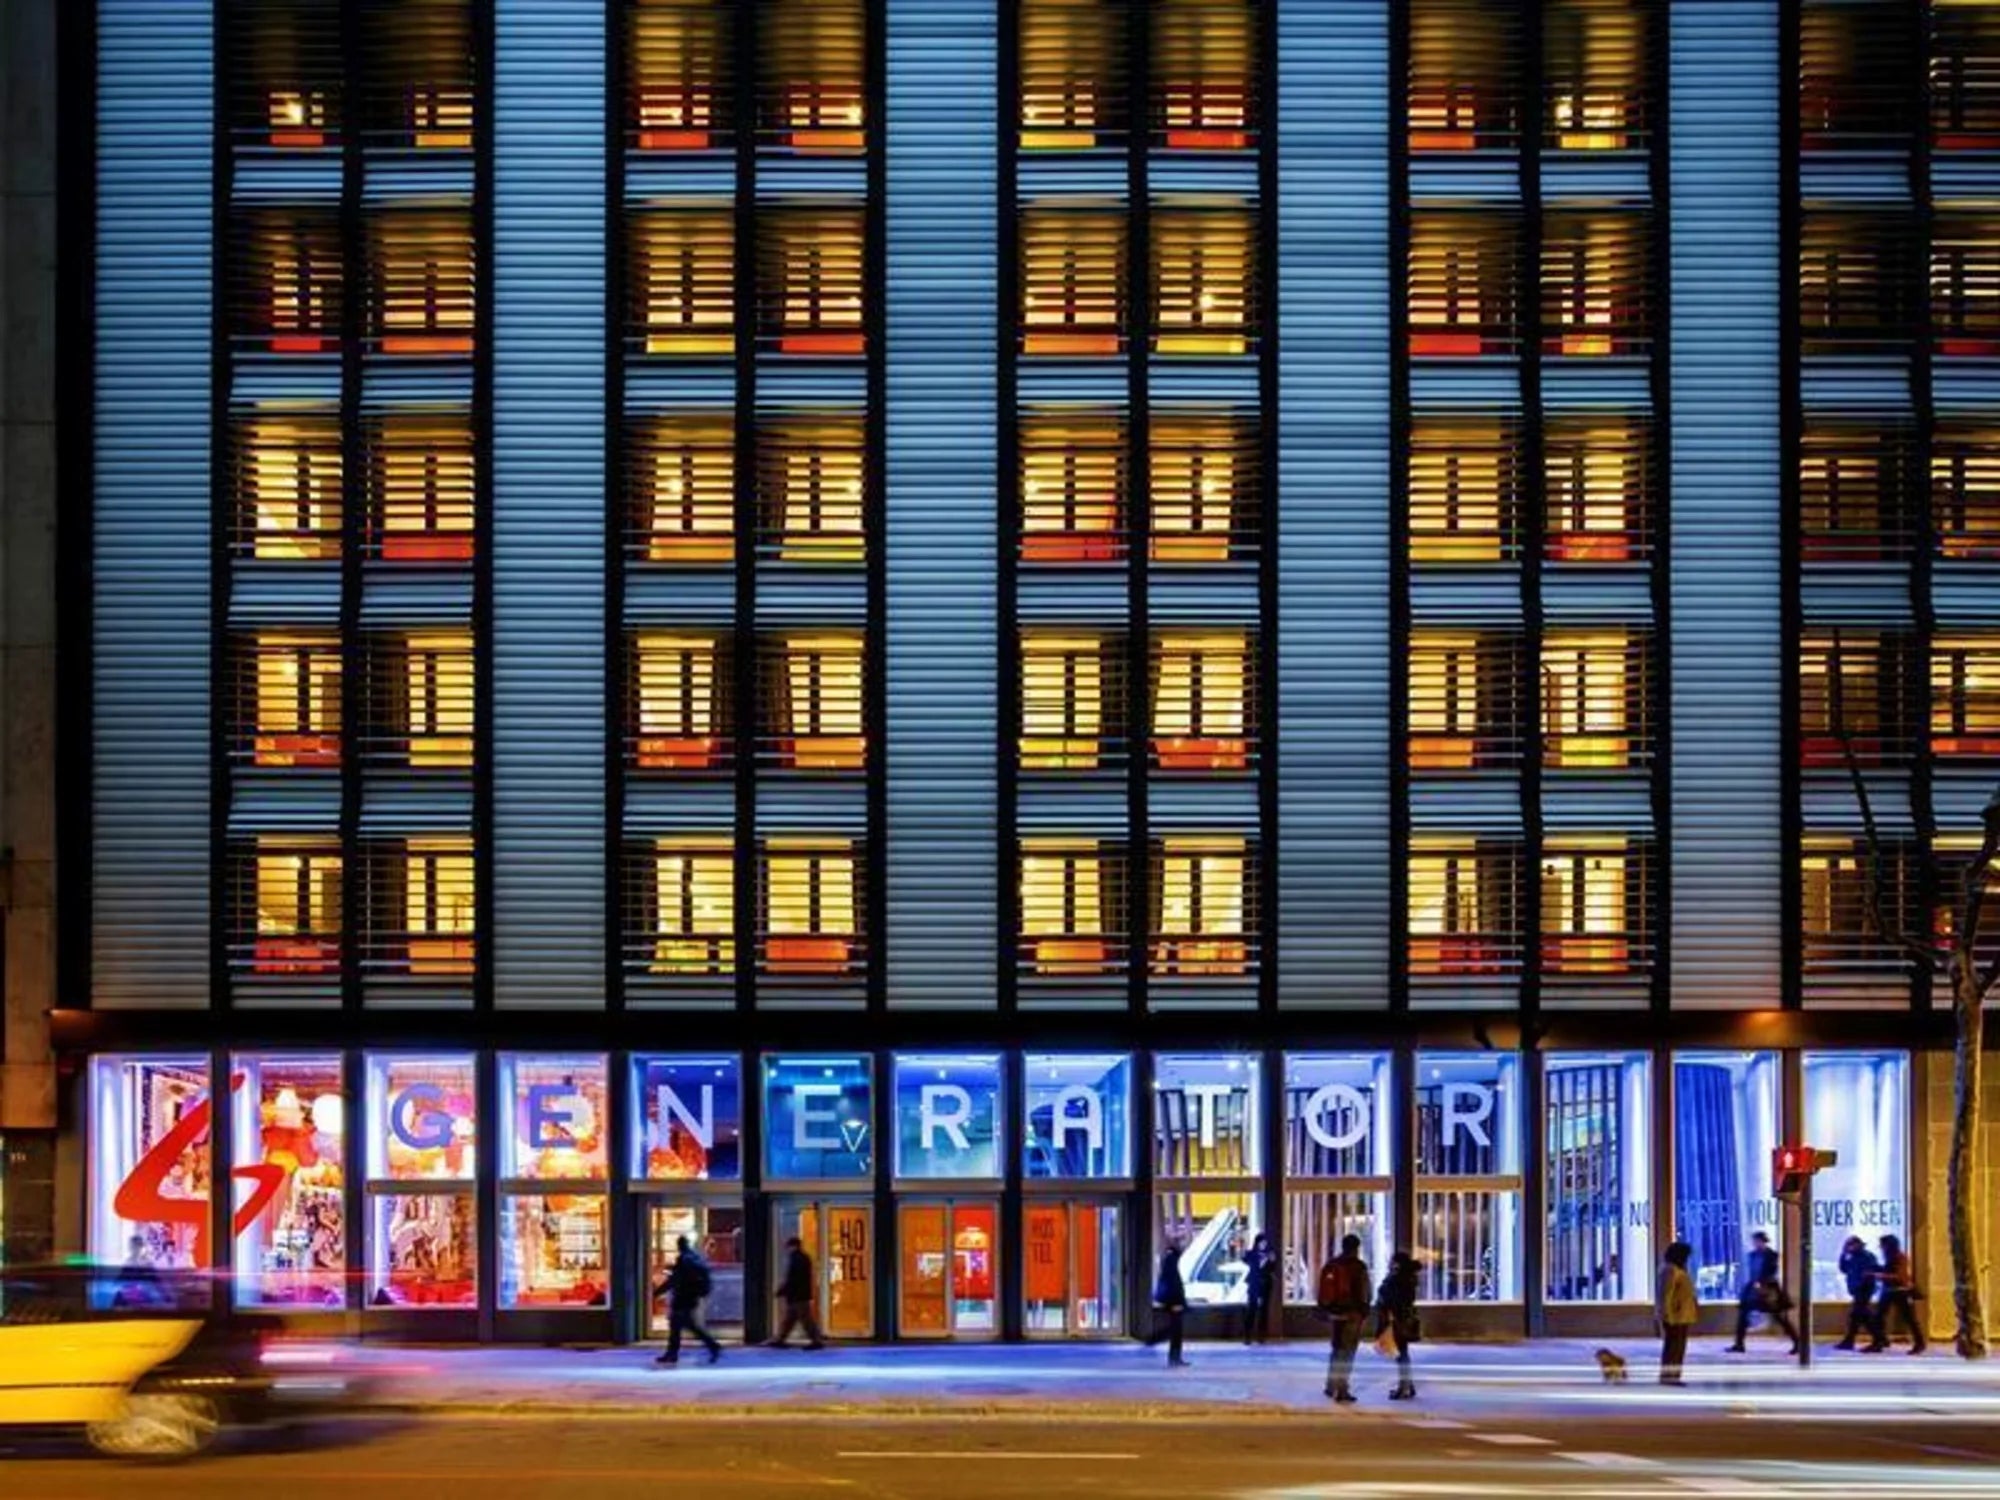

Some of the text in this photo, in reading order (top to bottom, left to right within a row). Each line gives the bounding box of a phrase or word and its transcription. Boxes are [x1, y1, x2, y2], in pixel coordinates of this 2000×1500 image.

[391, 1083, 1491, 1149] GENERATOR
[1859, 1200, 1900, 1226] SEEN
[840, 1218, 865, 1251] HO
[839, 1254, 867, 1281] TEL
